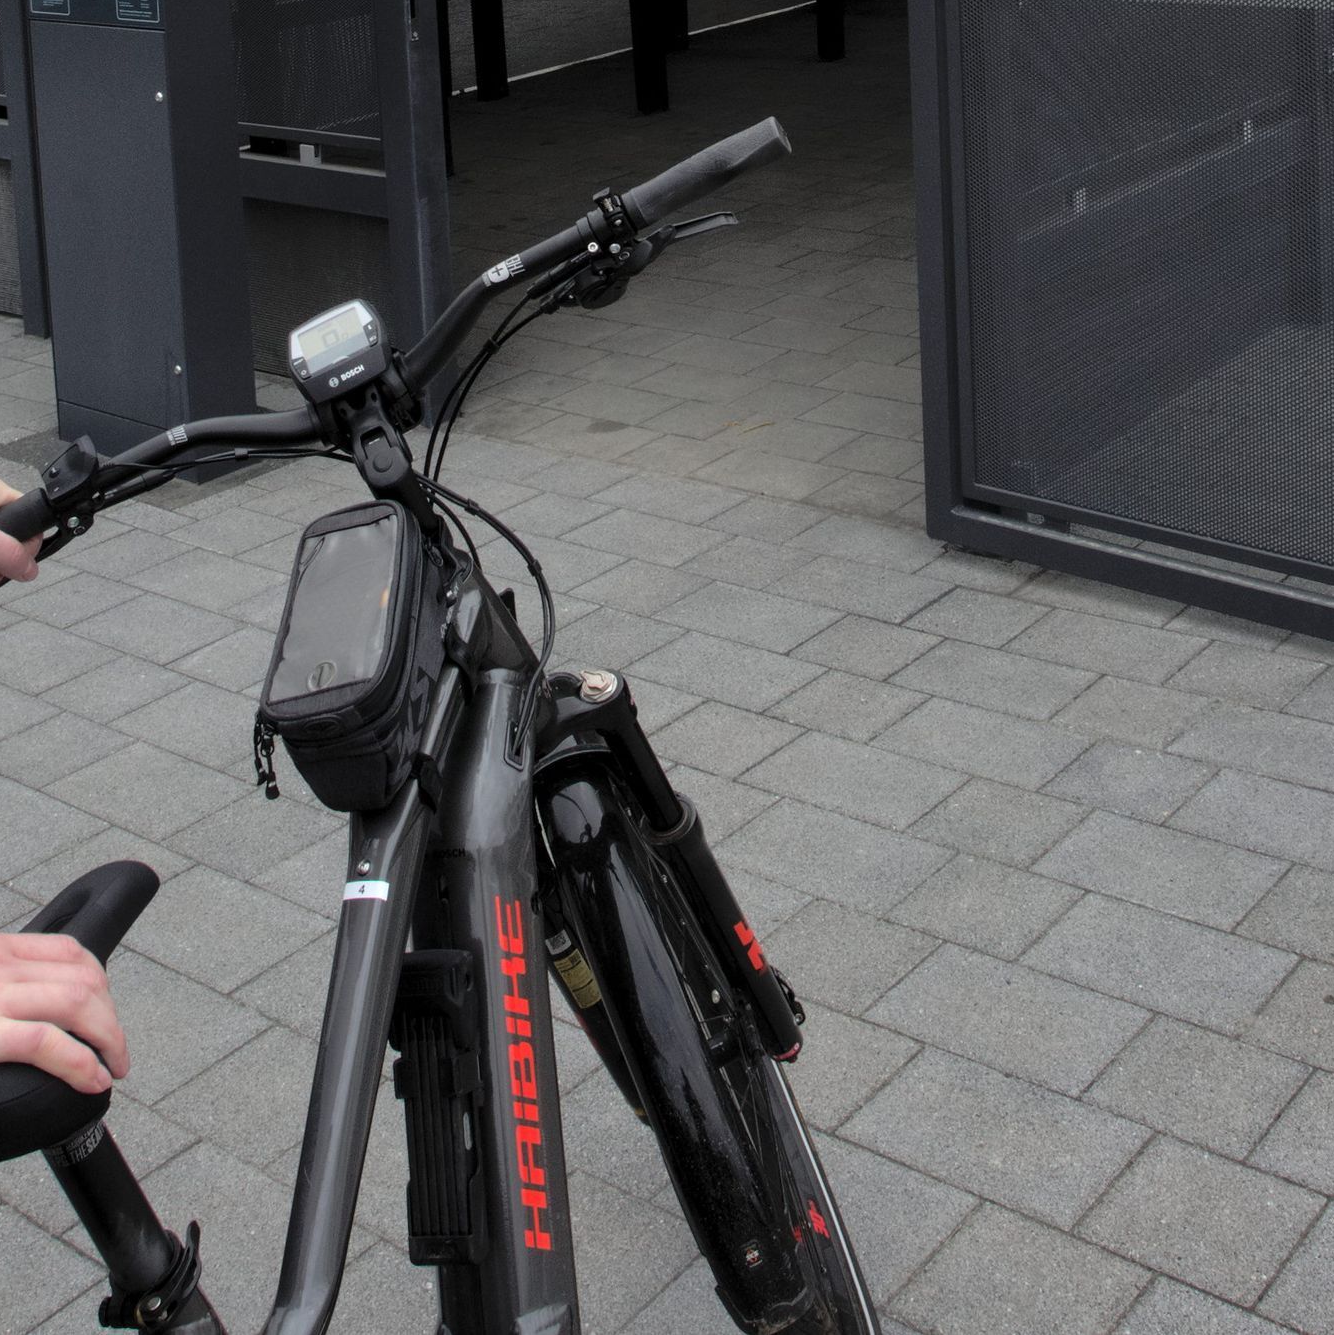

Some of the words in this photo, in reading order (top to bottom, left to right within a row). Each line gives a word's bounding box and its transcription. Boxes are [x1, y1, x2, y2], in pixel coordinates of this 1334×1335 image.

[340, 364, 365, 381] BOSCH
[358, 884, 366, 894] 4
[494, 895, 552, 1251] HAIBIKE
